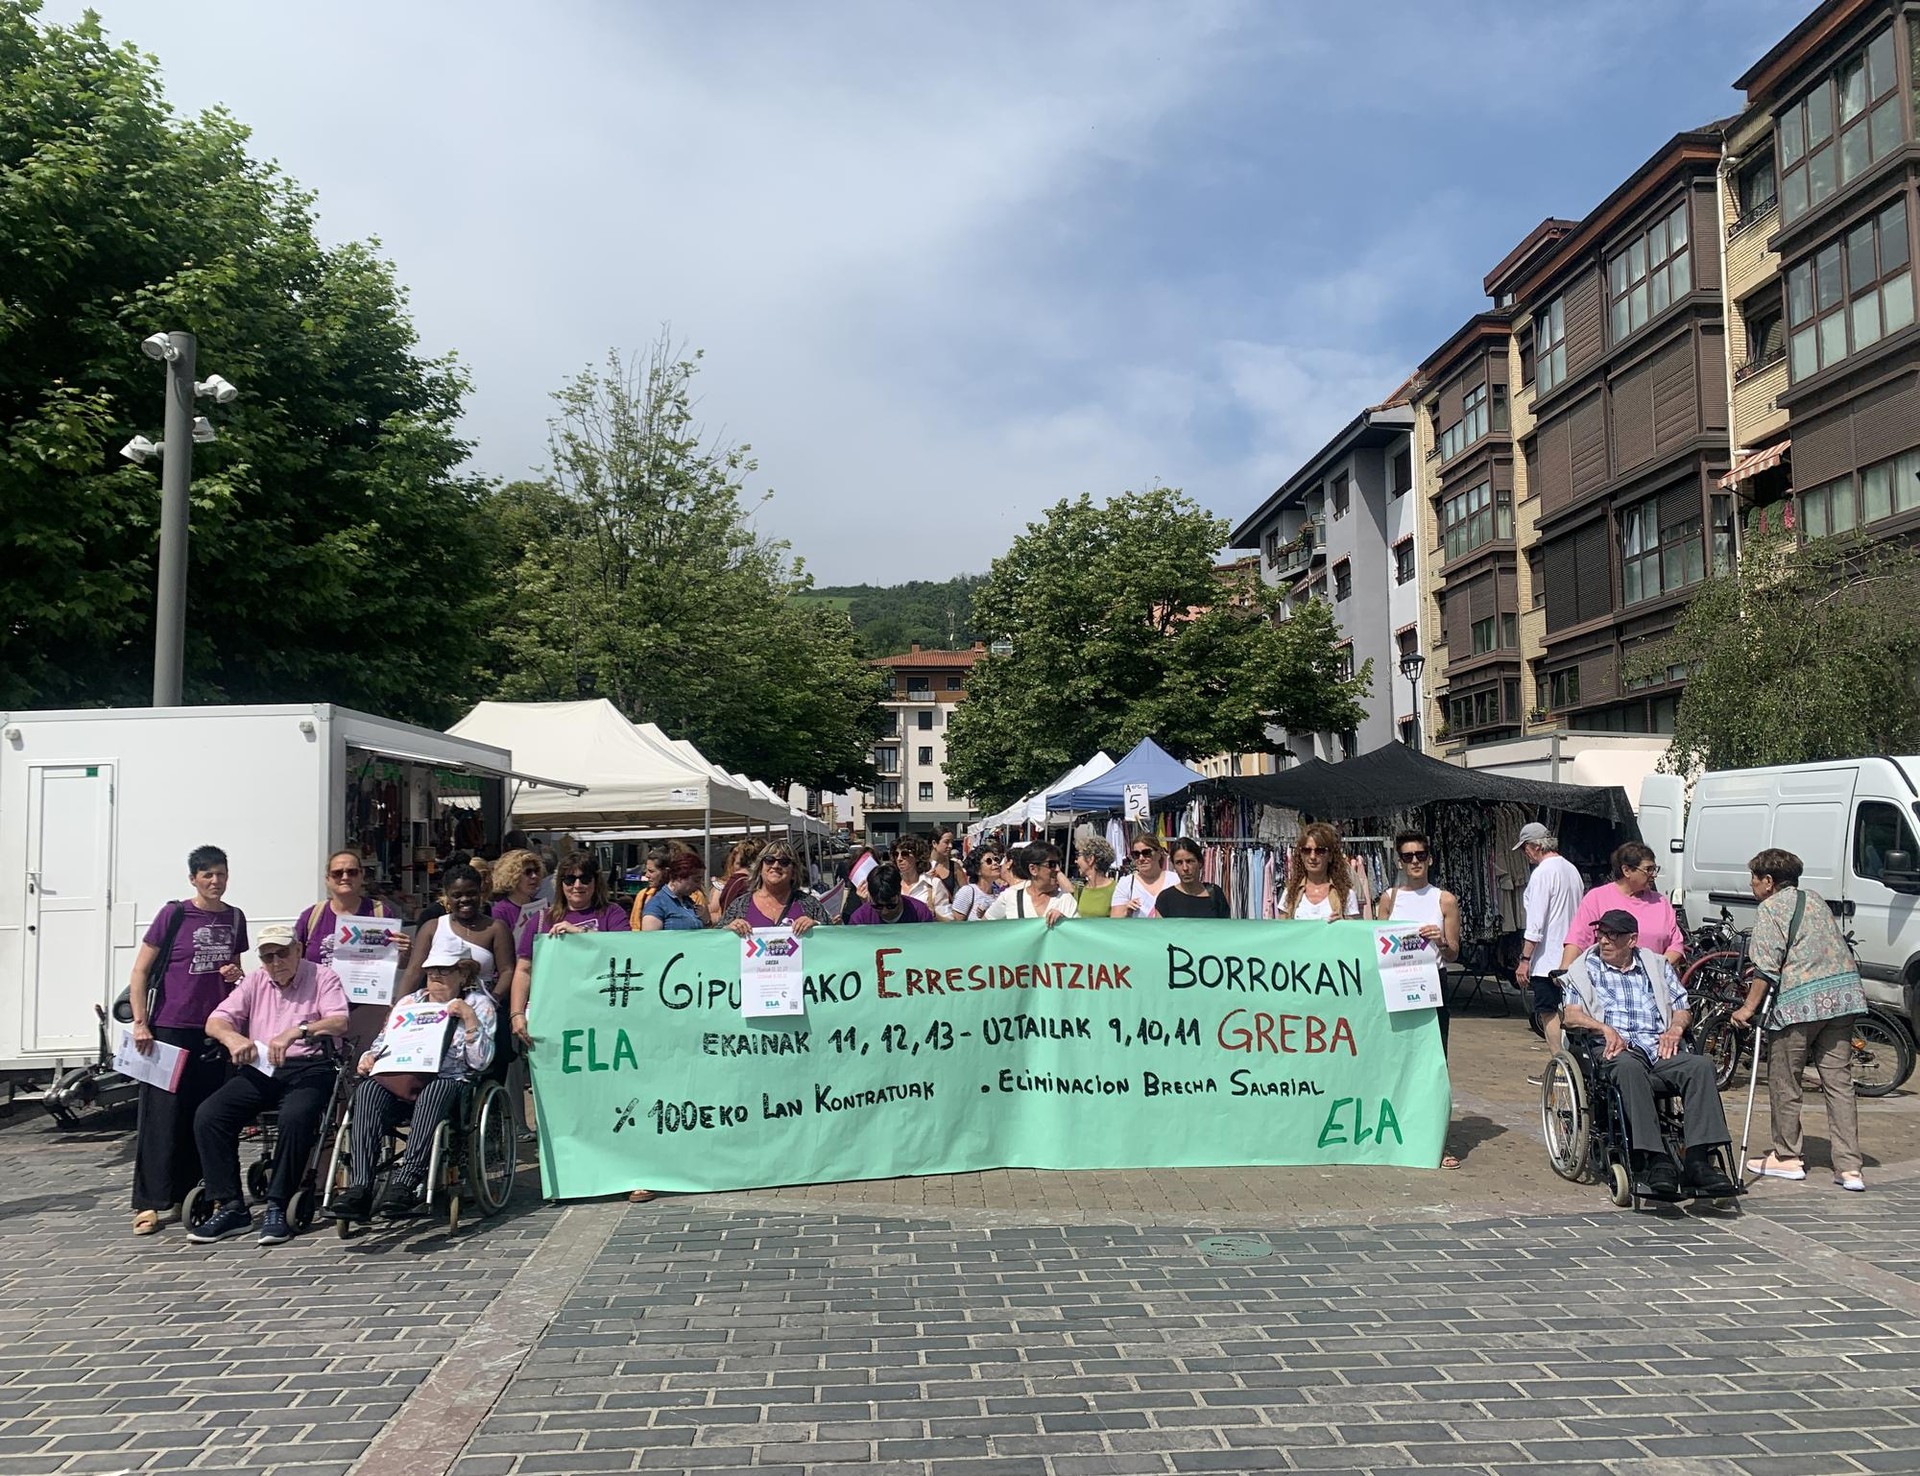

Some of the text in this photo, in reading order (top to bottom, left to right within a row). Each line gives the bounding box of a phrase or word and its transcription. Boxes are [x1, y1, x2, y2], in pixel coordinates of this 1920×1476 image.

[875, 947, 1133, 1000] ERRESIDENTZIAK
[1166, 943, 1363, 997] BORROKAN
[562, 1028, 639, 1074] ELA
[702, 1030, 811, 1057] EKAINAK
[982, 1014, 1092, 1046] UZTAILAK
[1217, 1008, 1358, 1057] GREBA
[1317, 1097, 1404, 1149] ELA
